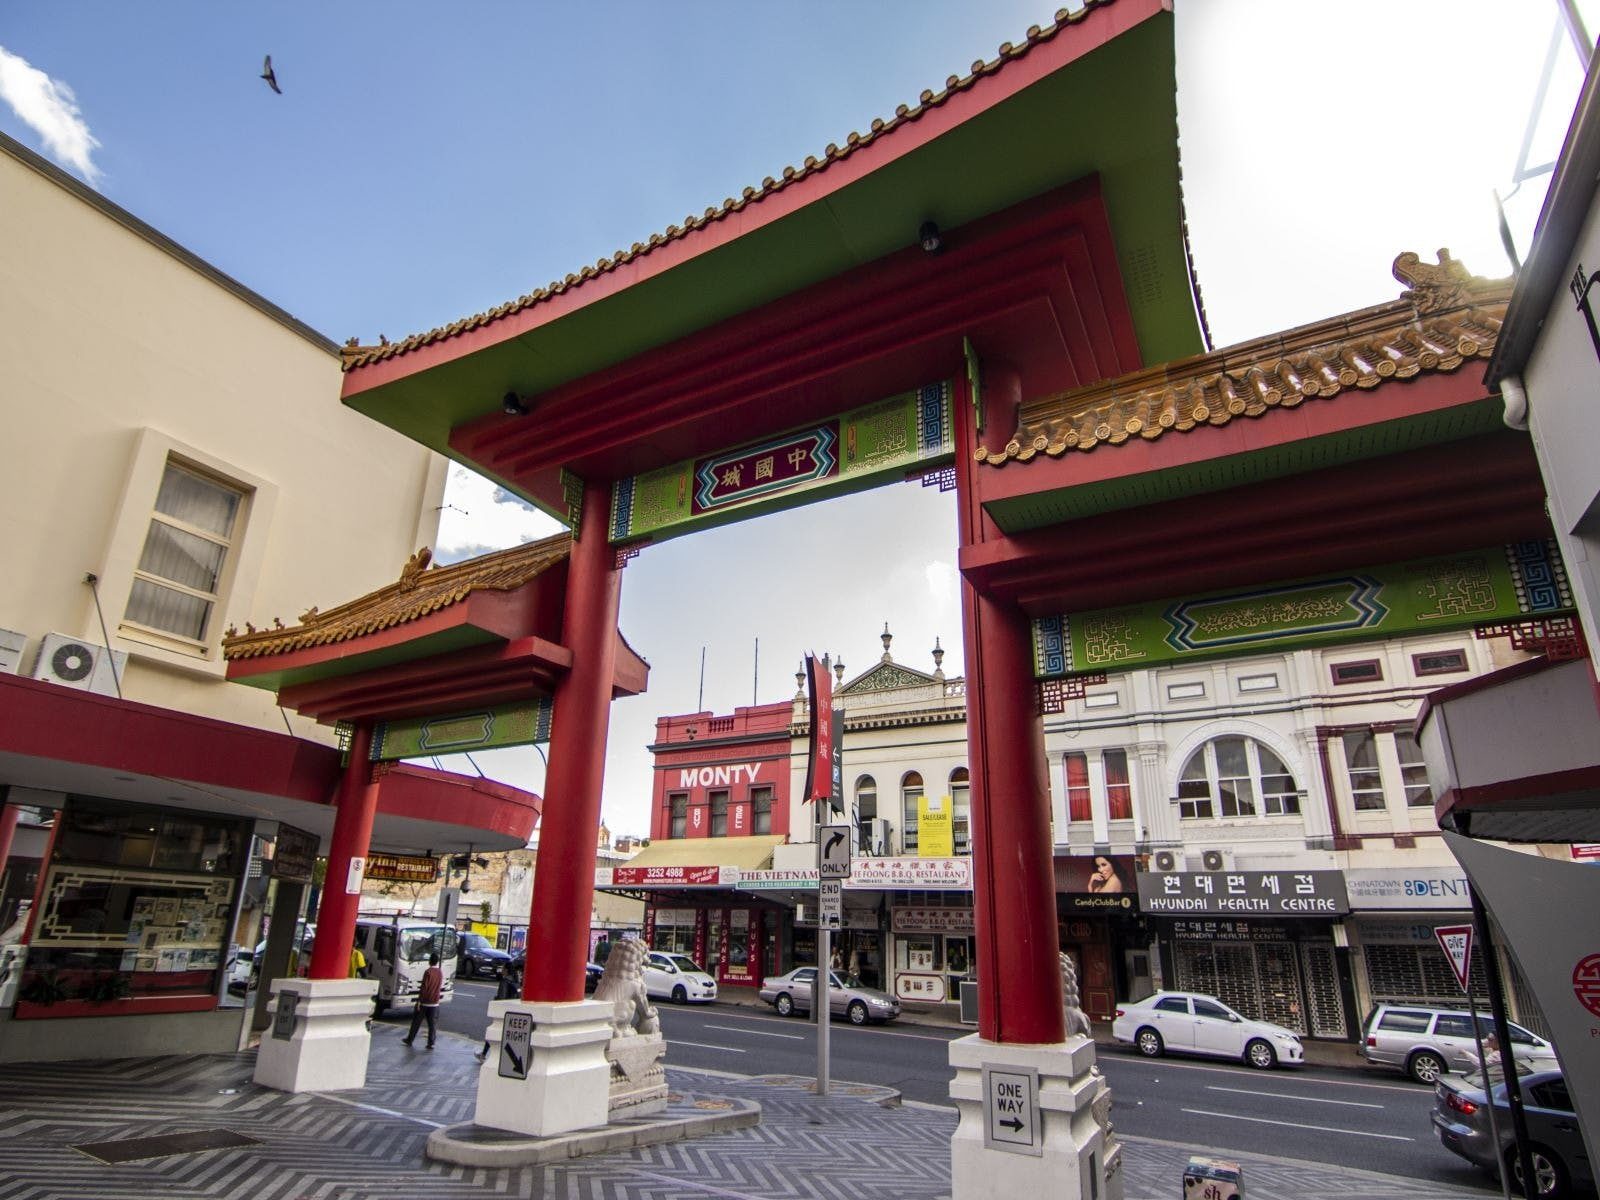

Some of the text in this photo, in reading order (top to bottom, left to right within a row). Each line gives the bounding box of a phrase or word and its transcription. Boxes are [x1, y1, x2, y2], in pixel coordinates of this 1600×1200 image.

[679, 762, 762, 788] MONTY
[693, 808, 701, 829] BUY
[735, 805, 744, 829] SELL
[647, 868, 665, 878] 3252
[821, 863, 848, 873] ONLY
[863, 870, 890, 878] FOONG
[916, 870, 966, 878] RESTAURANT
[739, 871, 762, 880] THE
[821, 884, 839, 894] END
[1163, 874, 1316, 895] 현대면세점
[1149, 898, 1336, 911] HYUNDAI HEALTH CENTRE
[1175, 932, 1214, 940] HYUNDAI
[1217, 932, 1250, 940] HEALTH
[1447, 936, 1465, 949] GIVE
[508, 1018, 528, 1029] KEEP
[505, 1030, 528, 1043] RIGHT
[997, 1083, 1023, 1098] ONE
[997, 1098, 1024, 1114] WAY
